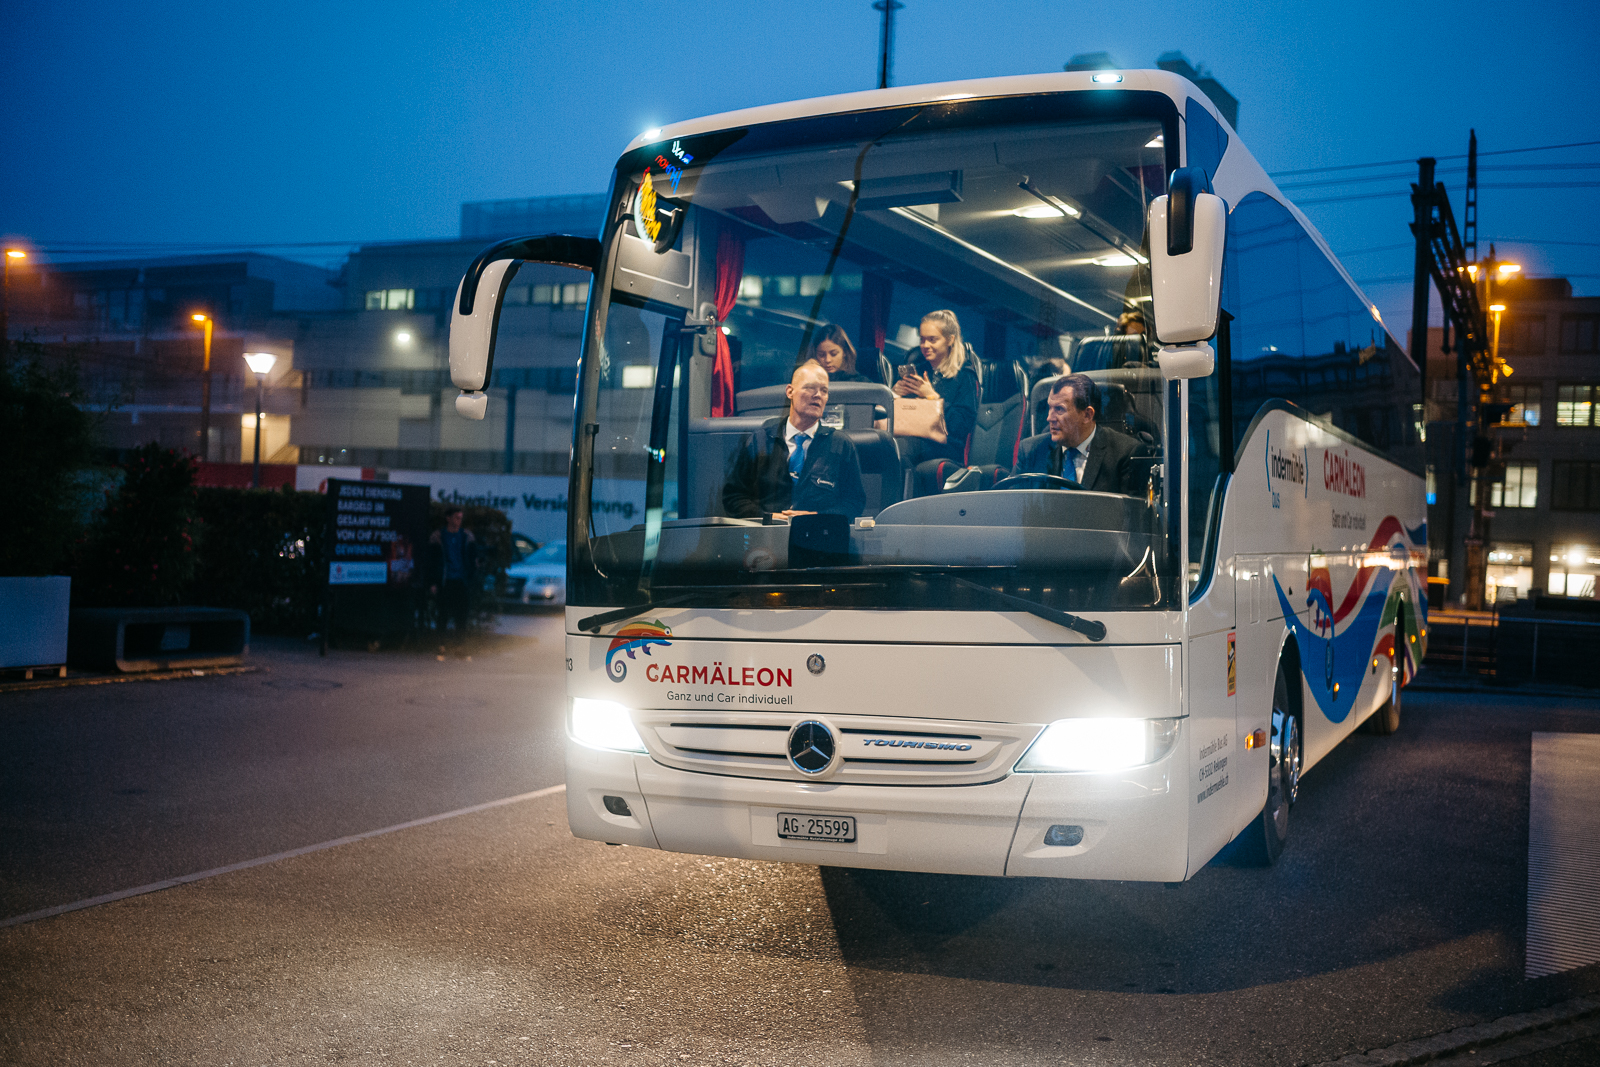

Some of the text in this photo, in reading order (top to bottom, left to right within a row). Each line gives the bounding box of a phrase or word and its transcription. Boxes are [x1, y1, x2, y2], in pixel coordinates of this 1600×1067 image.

[1271, 446, 1304, 485] indermühle
[1323, 448, 1366, 499] CARMÄLEON
[646, 661, 793, 687] CARMÄLEON
[667, 691, 793, 705] Ganz und Car individuell
[863, 738, 972, 752] TOURISMO
